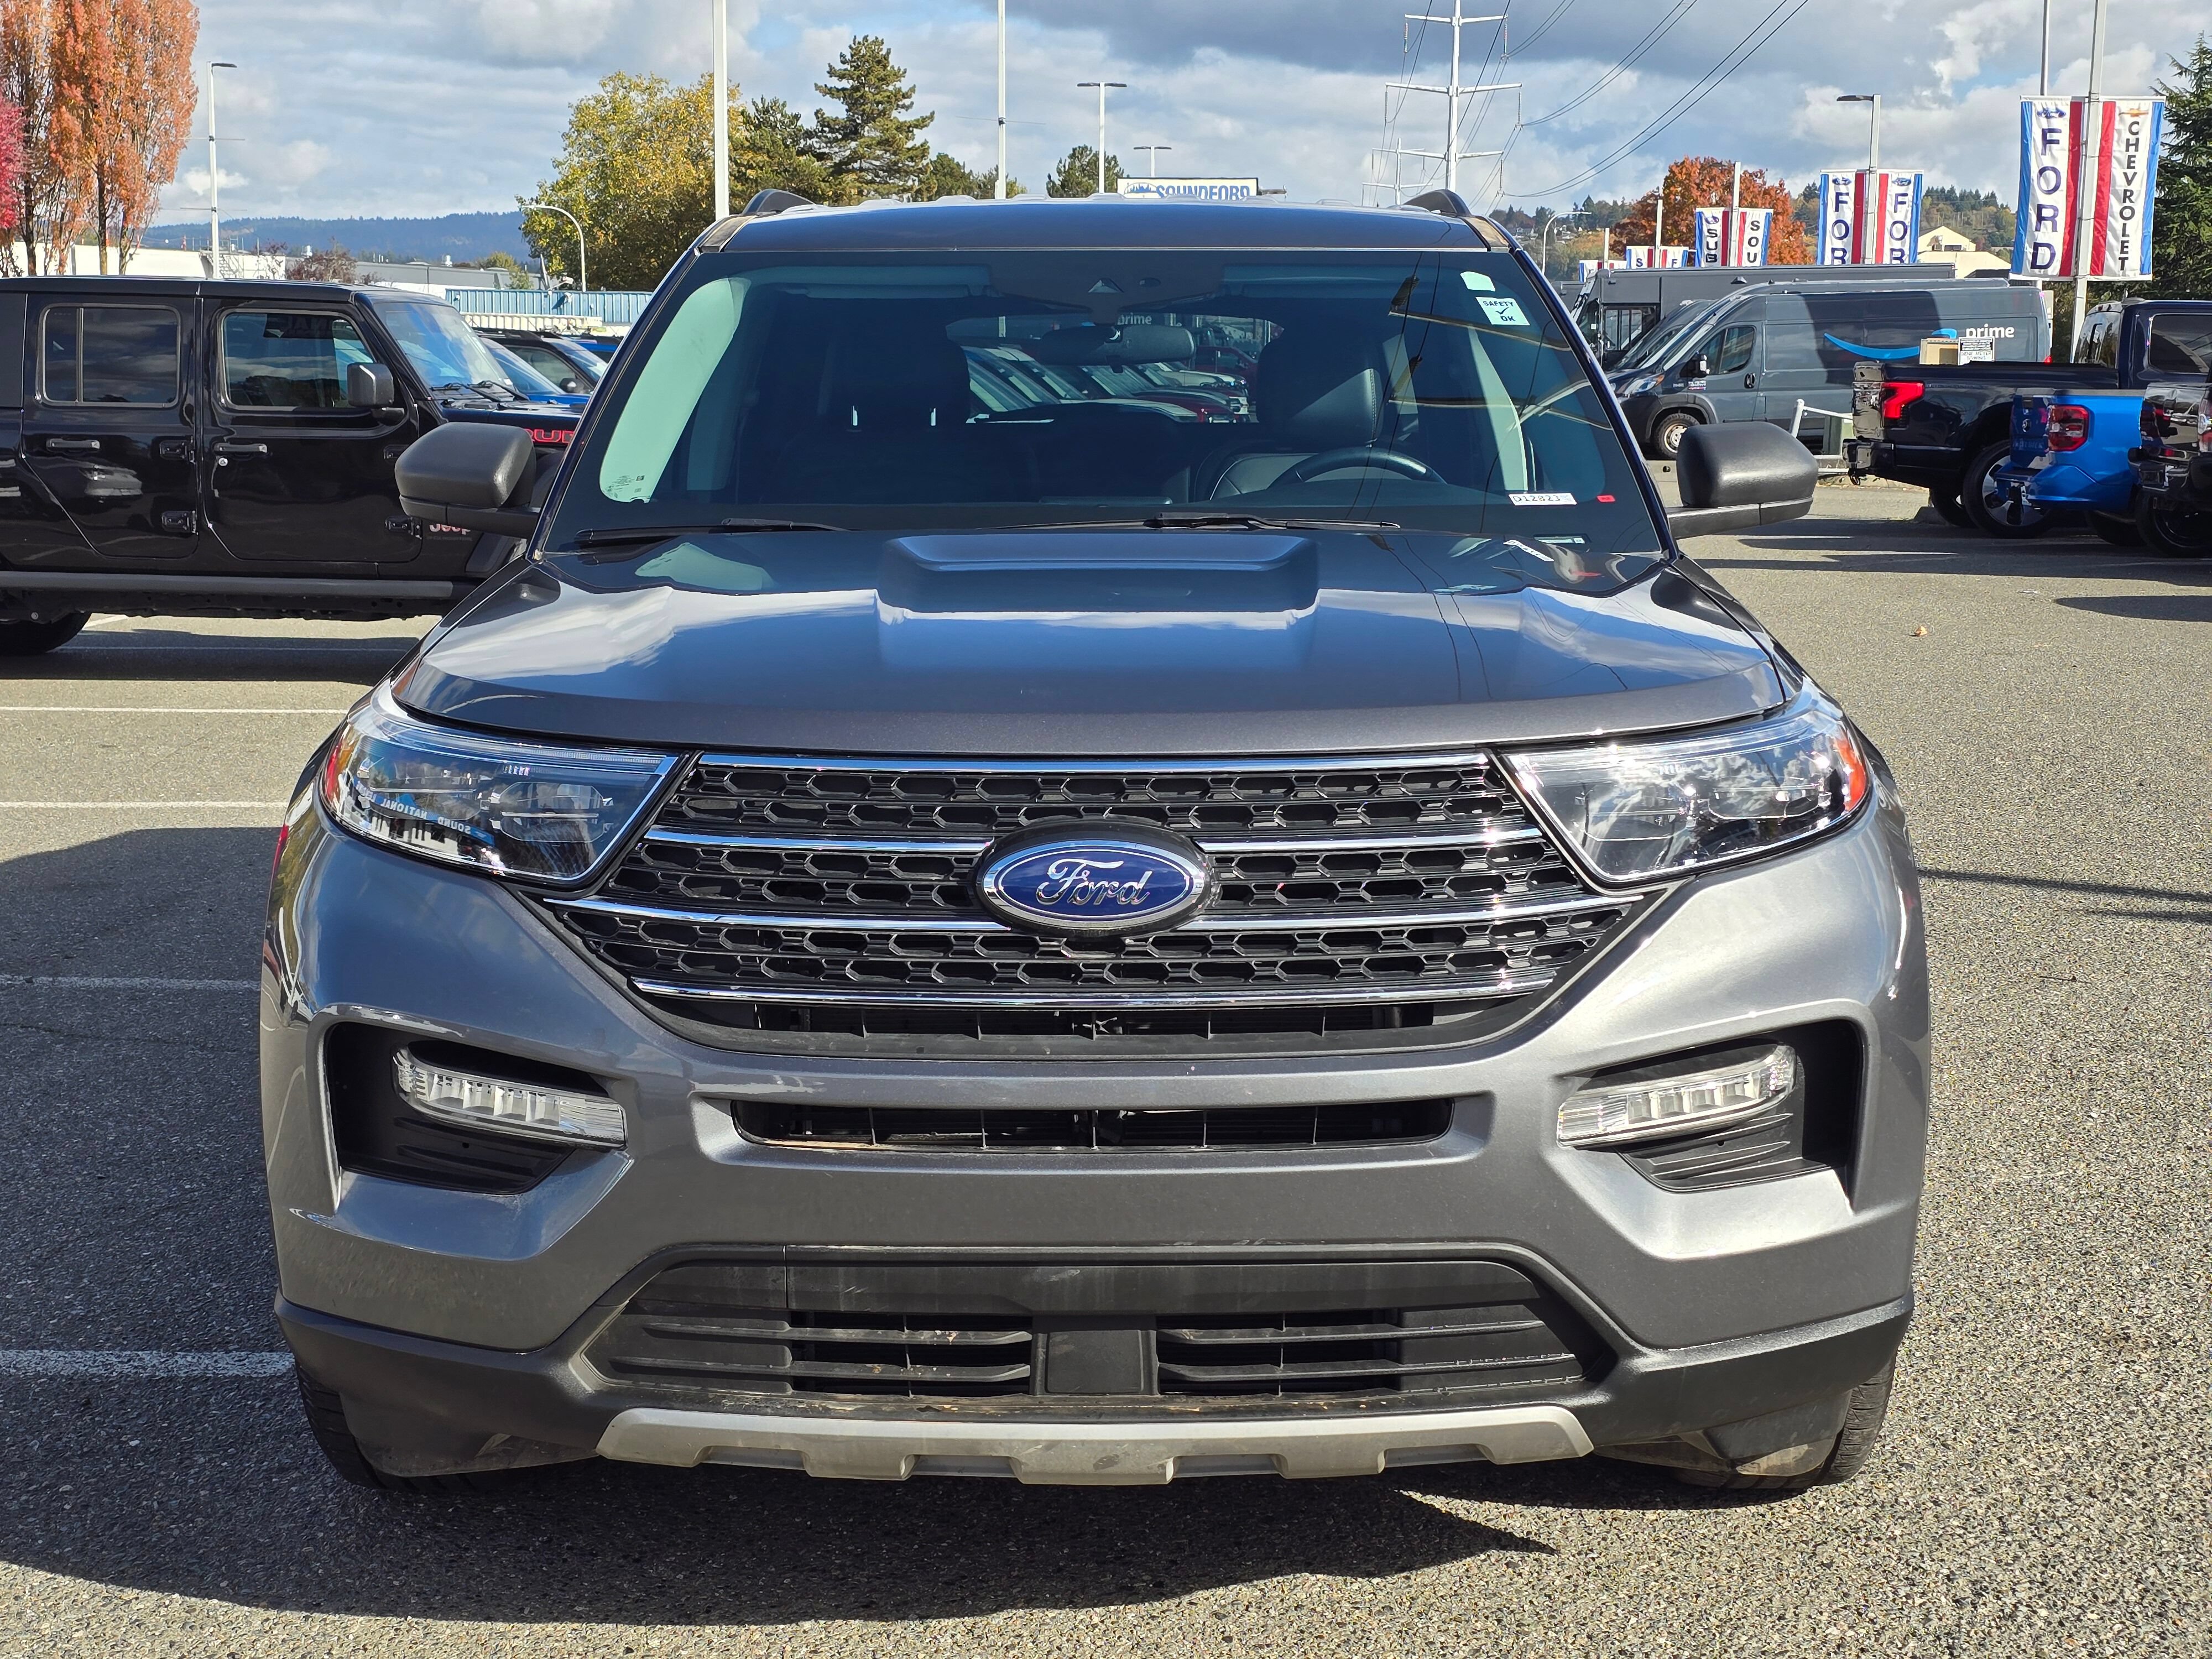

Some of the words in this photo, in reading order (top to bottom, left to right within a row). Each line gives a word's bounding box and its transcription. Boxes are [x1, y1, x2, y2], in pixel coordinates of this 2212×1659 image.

[2031, 128, 2062, 270] FORD
[2118, 121, 2140, 271] CHEVROLET
[1966, 324, 2015, 338] prime
[1036, 858, 1152, 905] Ford
